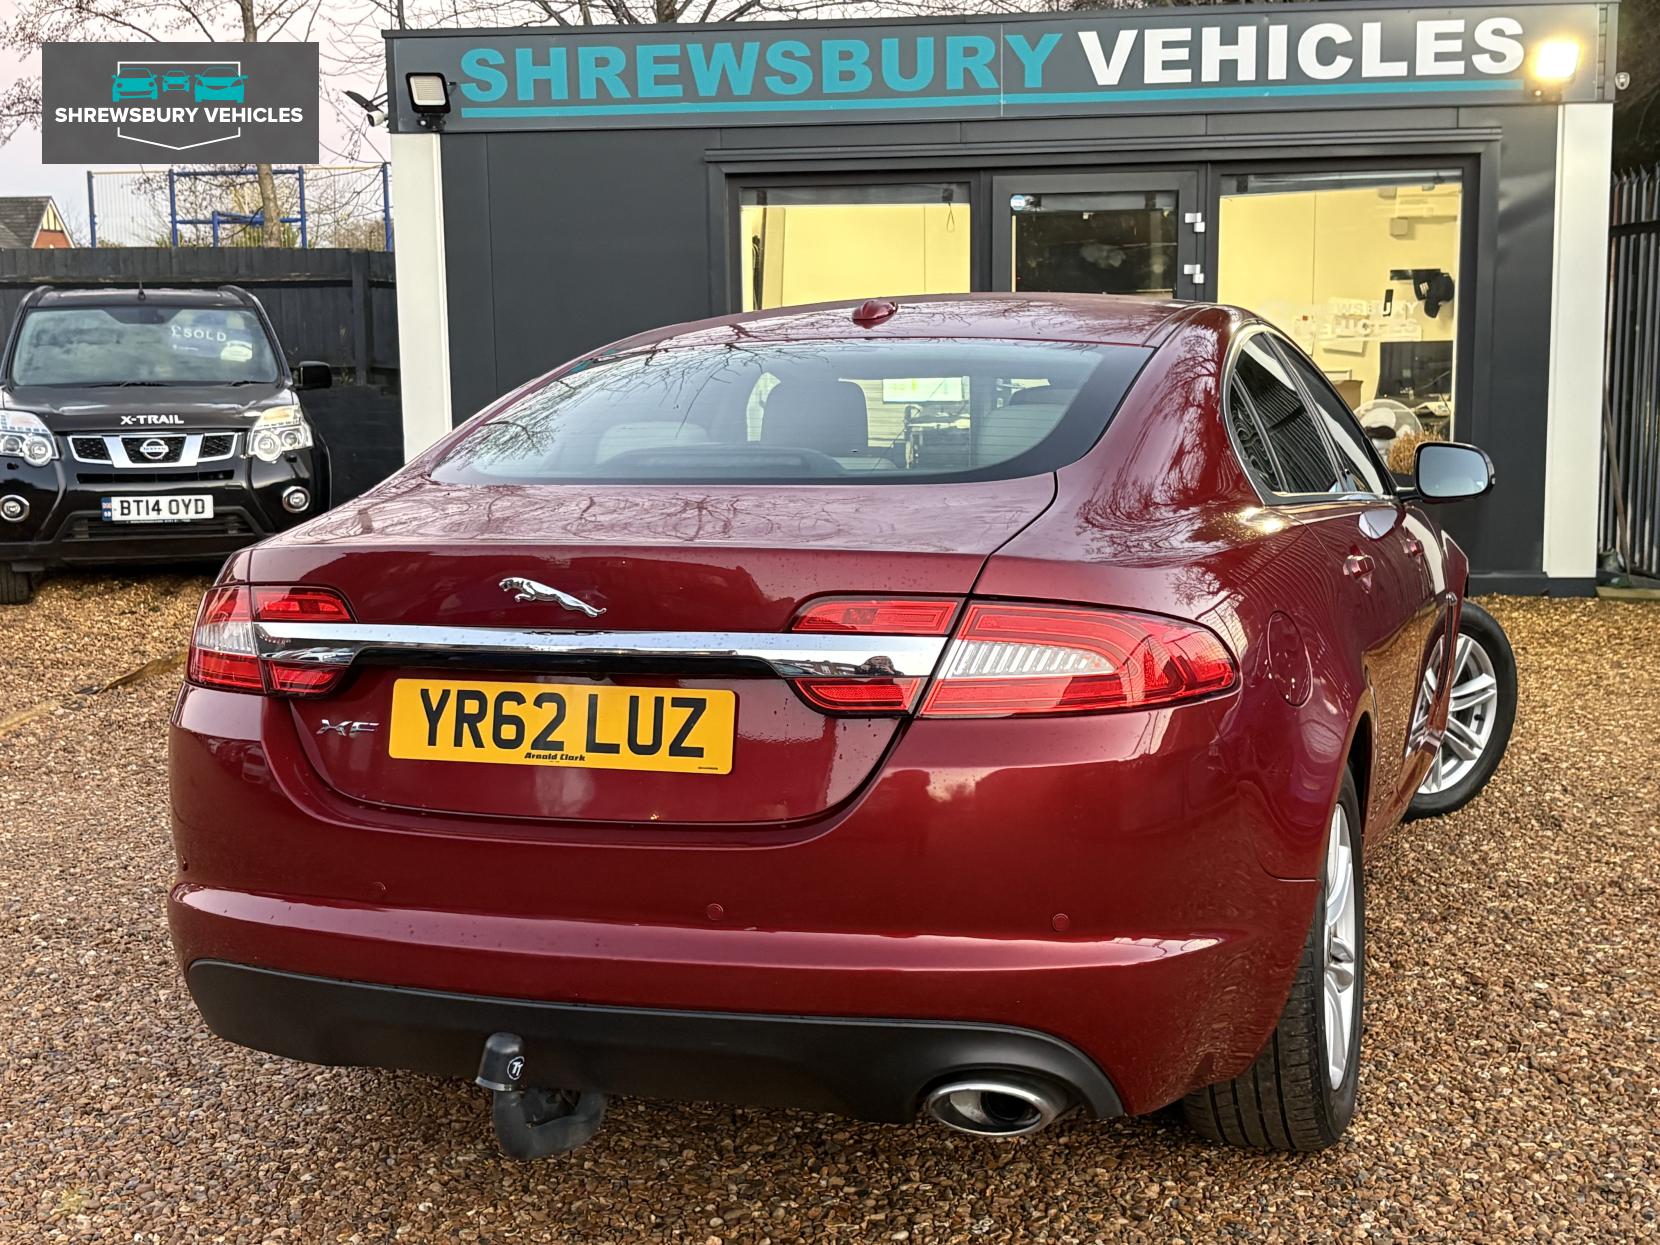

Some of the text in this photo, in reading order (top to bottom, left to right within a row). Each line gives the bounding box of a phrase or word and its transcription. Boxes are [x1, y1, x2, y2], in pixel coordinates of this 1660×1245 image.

[461, 17, 1525, 102] SHREWSBURY VEHICLES
[120, 414, 185, 425] X-TRAIL
[120, 499, 162, 516] BT14
[168, 498, 205, 515] OYD
[316, 719, 380, 737] XF
[419, 688, 708, 759] YR62 LUZ
[524, 752, 586, 761] Arnold Clark
